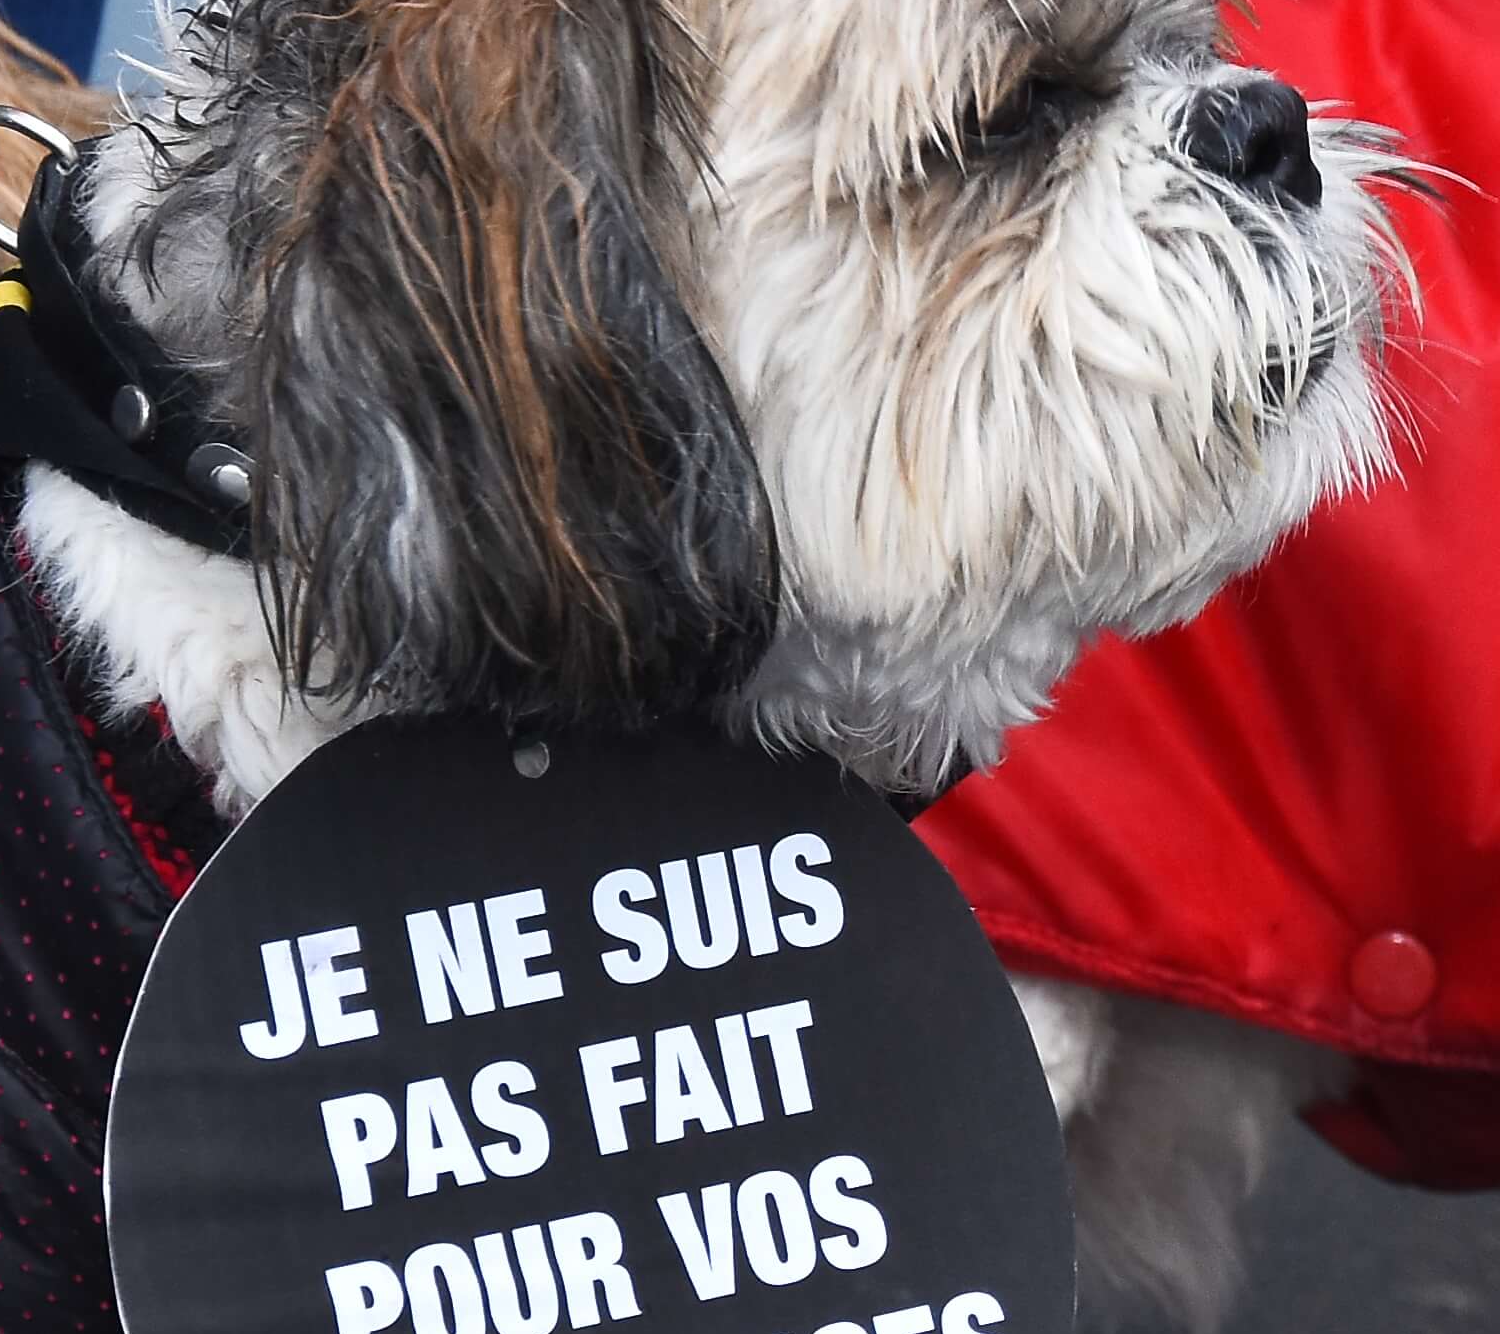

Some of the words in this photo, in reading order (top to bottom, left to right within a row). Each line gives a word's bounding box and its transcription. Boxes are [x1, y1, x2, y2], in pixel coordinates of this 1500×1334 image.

[238, 924, 381, 1061] JE
[404, 887, 565, 1025] NE
[591, 832, 845, 985] SUIS
[319, 1059, 551, 1212] PAS
[577, 998, 815, 1157] FAIT
[655, 1154, 889, 1302] VOS
